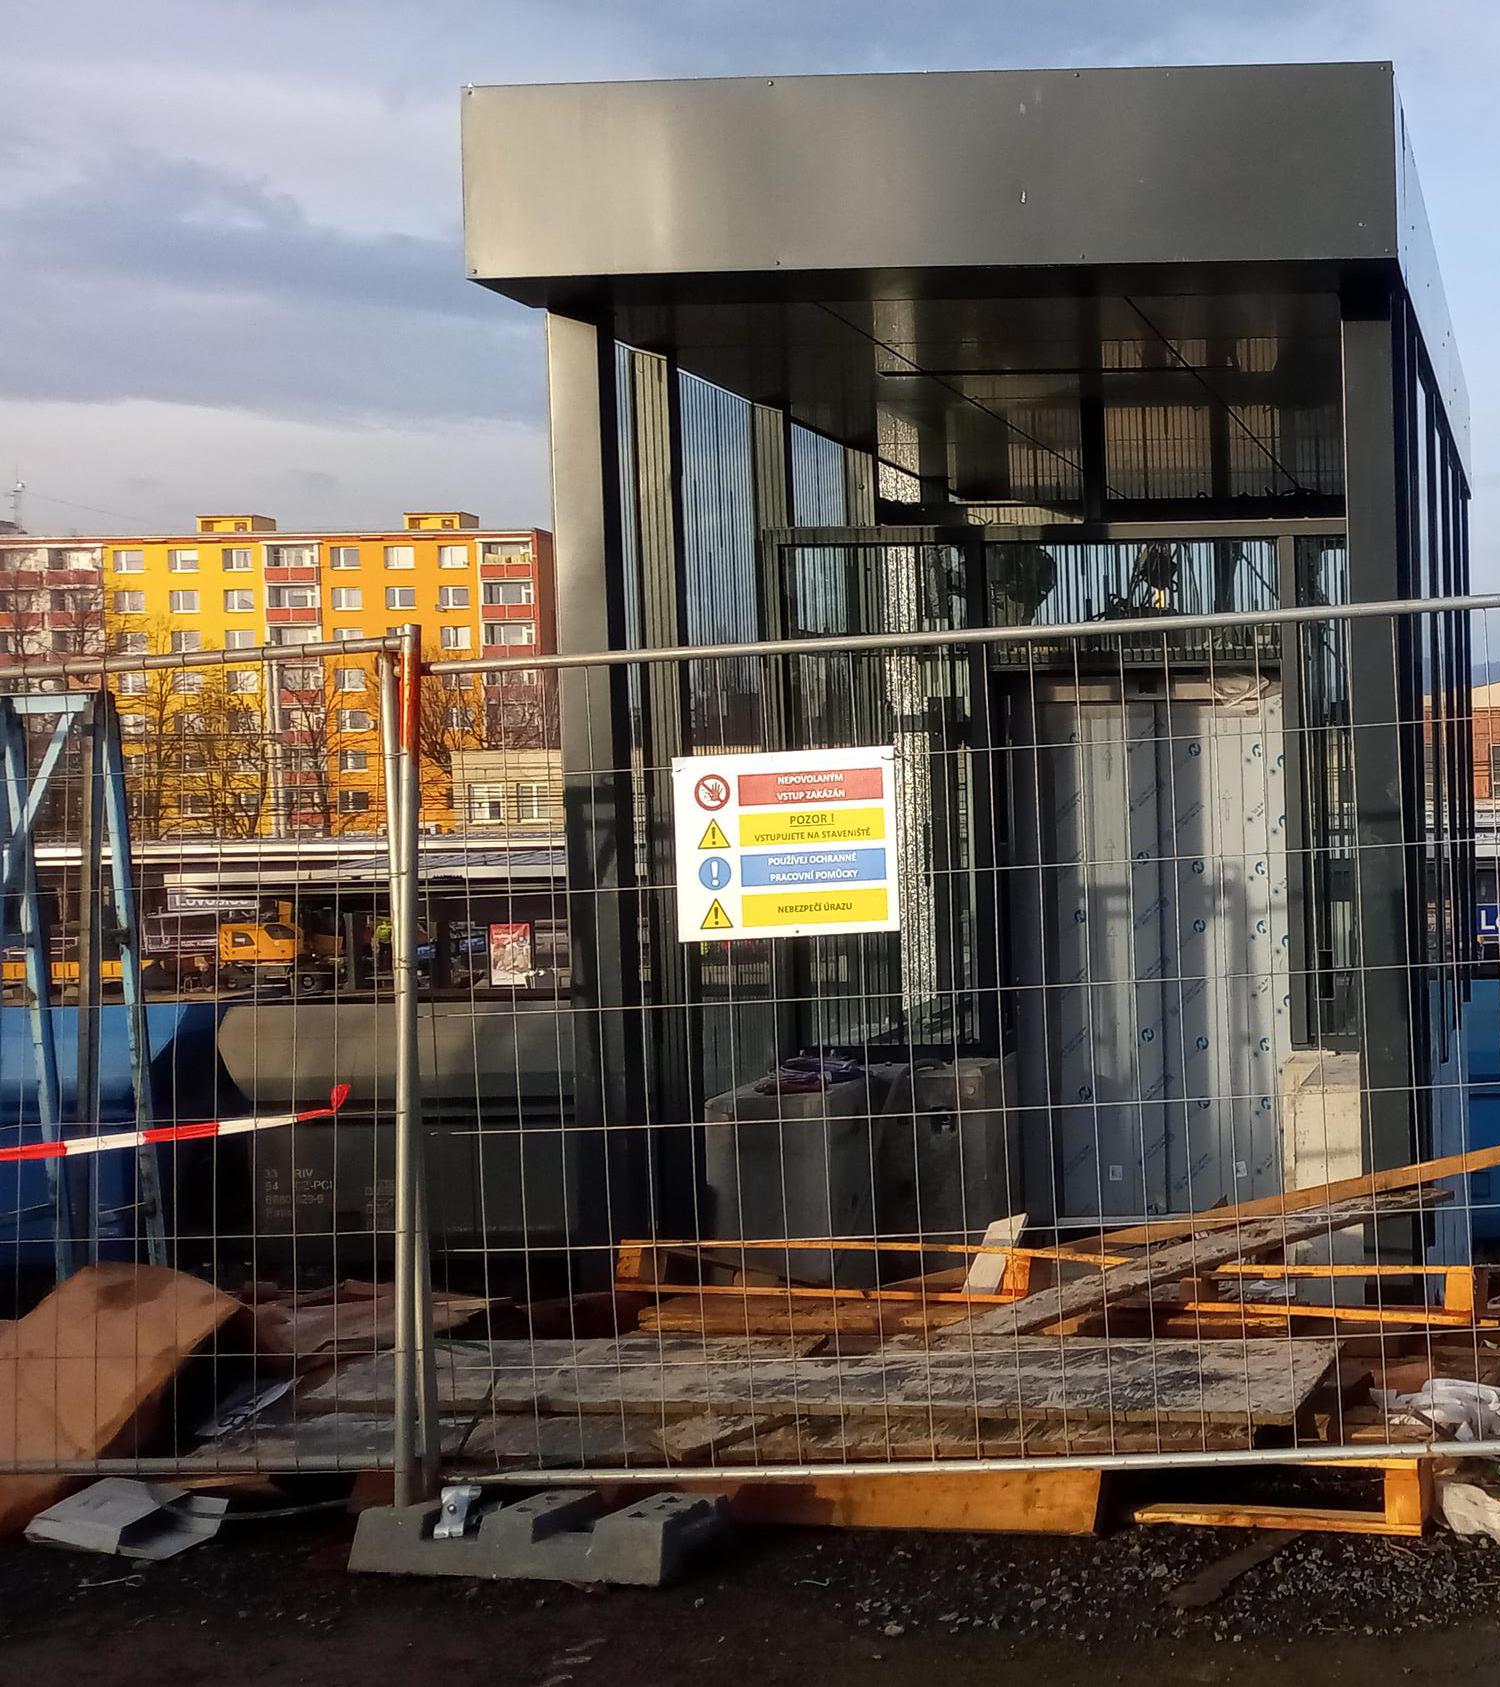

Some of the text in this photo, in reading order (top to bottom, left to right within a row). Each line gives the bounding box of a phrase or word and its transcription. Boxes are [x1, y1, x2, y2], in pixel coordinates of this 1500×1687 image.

[777, 773, 844, 785] NEPOVOLANÝM
[776, 789, 846, 801] VSTUP ZAKÁZÁN
[789, 813, 827, 825] POZOR
[754, 827, 871, 843] VSTUPUJETE NA STAVENIŠTĚ
[768, 853, 857, 866] POUŽÍVEJ OCHRANNÉ
[769, 869, 859, 882] PRACOVNÍ POMŮCKY
[778, 901, 853, 914] NEBEZPEČÍ ÚRAZU
